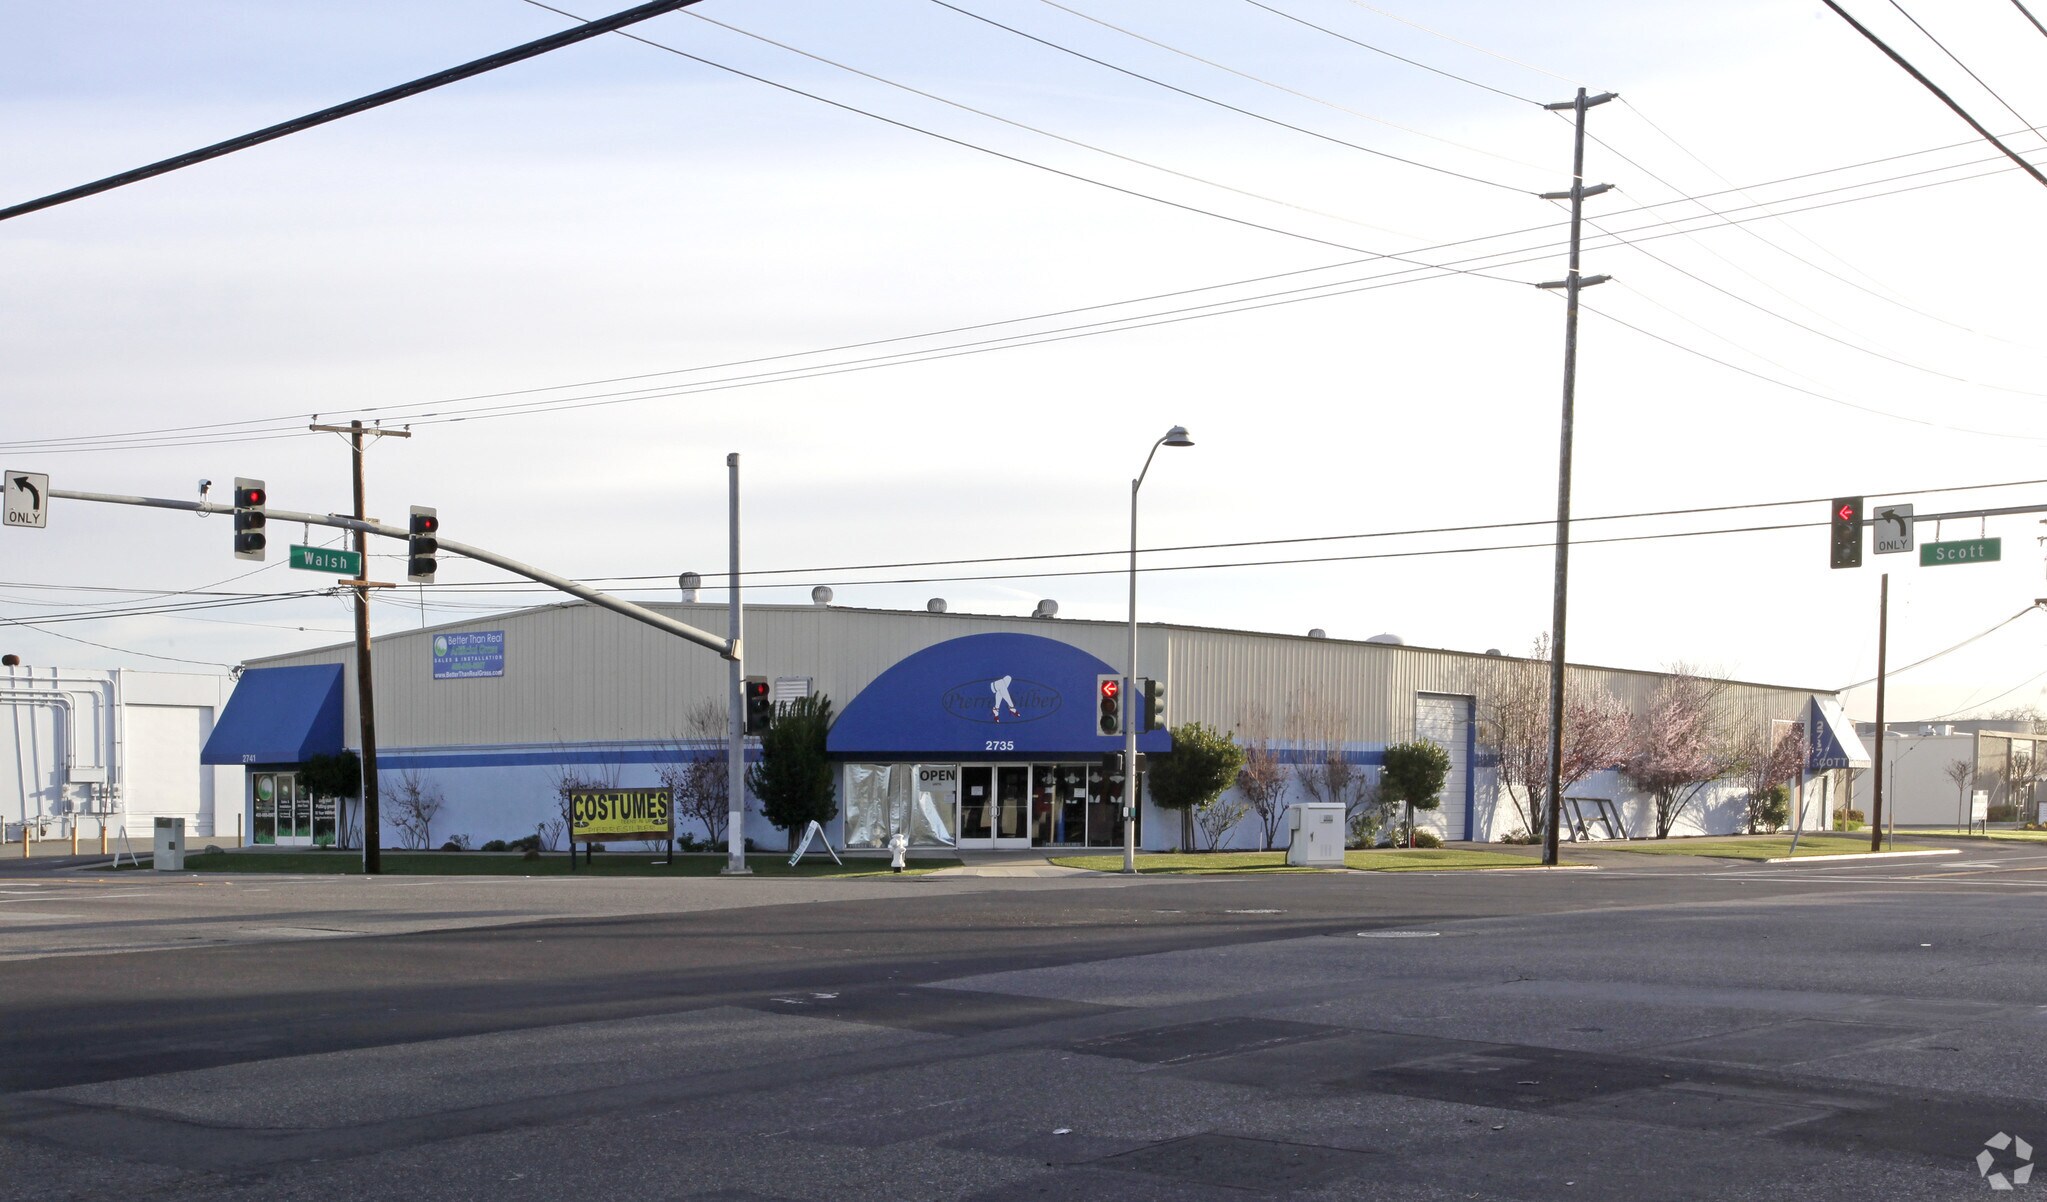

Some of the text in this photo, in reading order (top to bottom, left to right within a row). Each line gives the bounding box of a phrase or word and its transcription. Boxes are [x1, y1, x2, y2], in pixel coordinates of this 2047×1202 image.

[9, 511, 41, 524] ONLY
[1879, 539, 1908, 552] ONLY
[1936, 544, 1984, 561] Scott
[304, 551, 347, 569] Walsh
[448, 633, 503, 646] Better Than Real
[1015, 688, 1058, 710] ilber
[985, 740, 1014, 751] 2735
[242, 754, 256, 763] 2741
[1812, 757, 1848, 767] SCOTT
[920, 769, 955, 782] OPEN
[573, 791, 667, 821] COSTUMES
